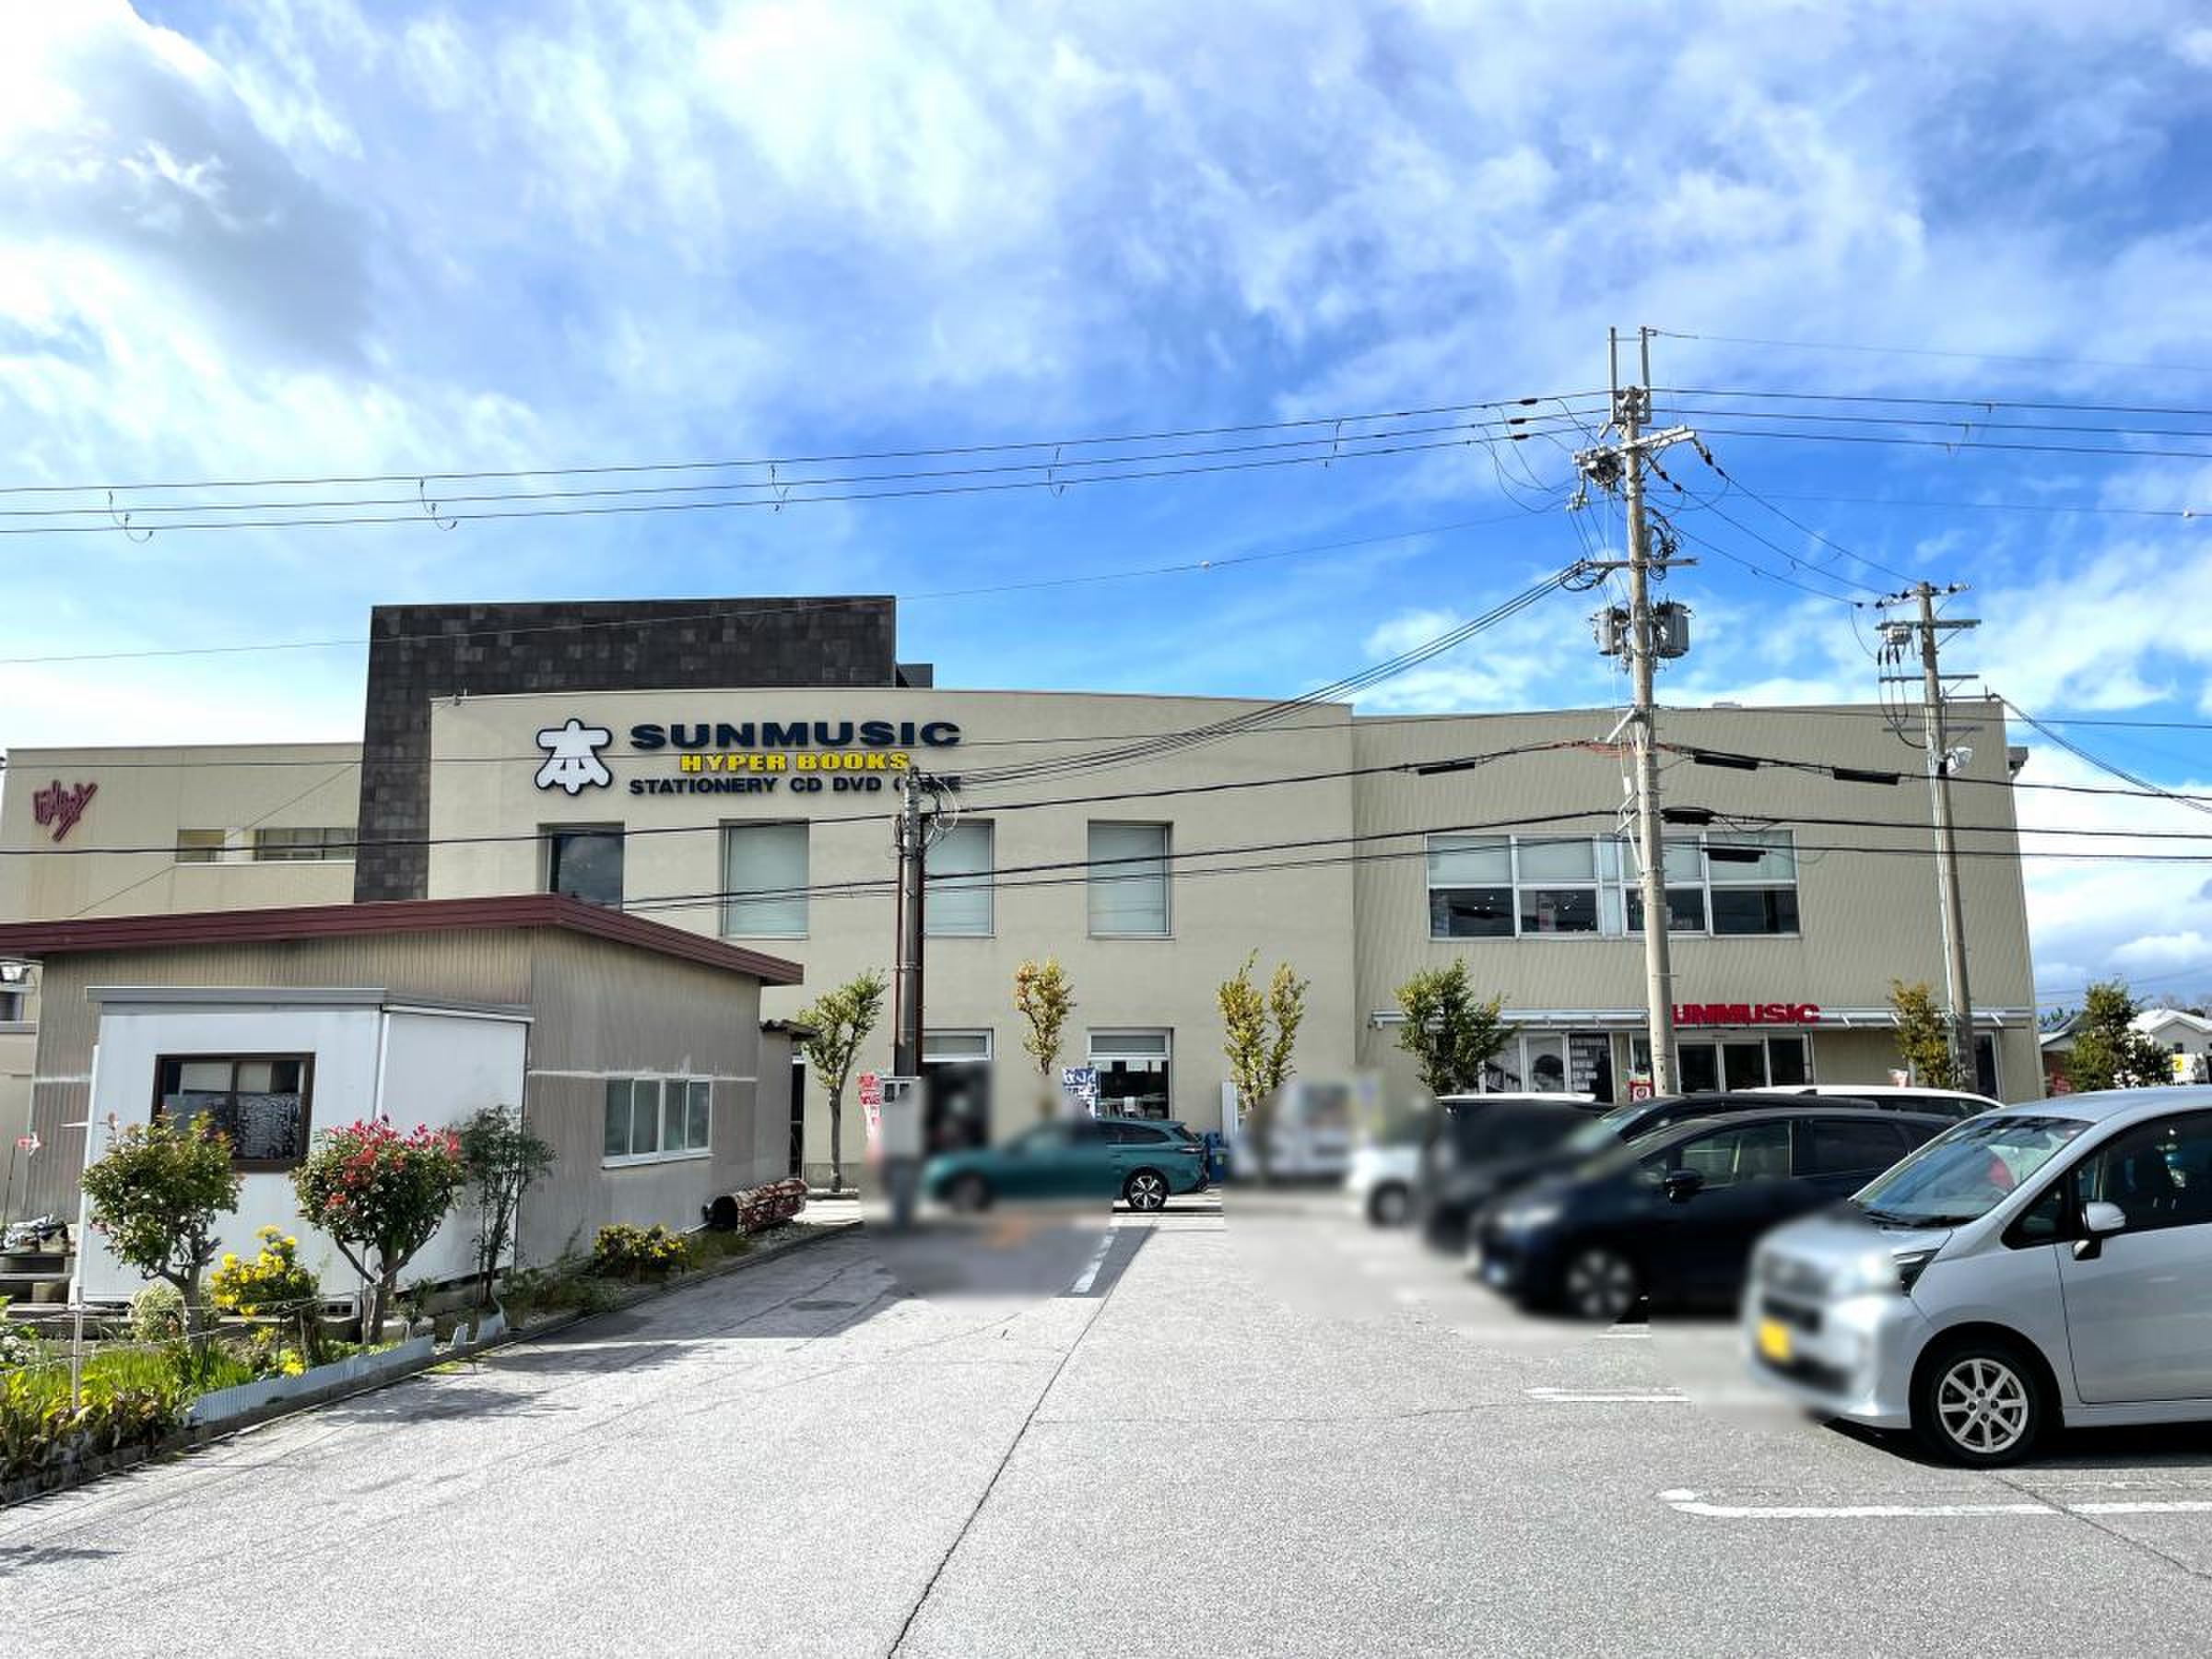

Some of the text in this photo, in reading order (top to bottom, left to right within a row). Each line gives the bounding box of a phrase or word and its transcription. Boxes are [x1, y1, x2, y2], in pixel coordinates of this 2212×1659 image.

[629, 722, 960, 749] SUNMUSIC
[679, 751, 911, 773] HYPER BOOKS
[629, 776, 778, 795] STATIONERY
[790, 776, 823, 794] CD
[832, 776, 882, 793] DVD
[1672, 1002, 1820, 1025] UNMUSIC
